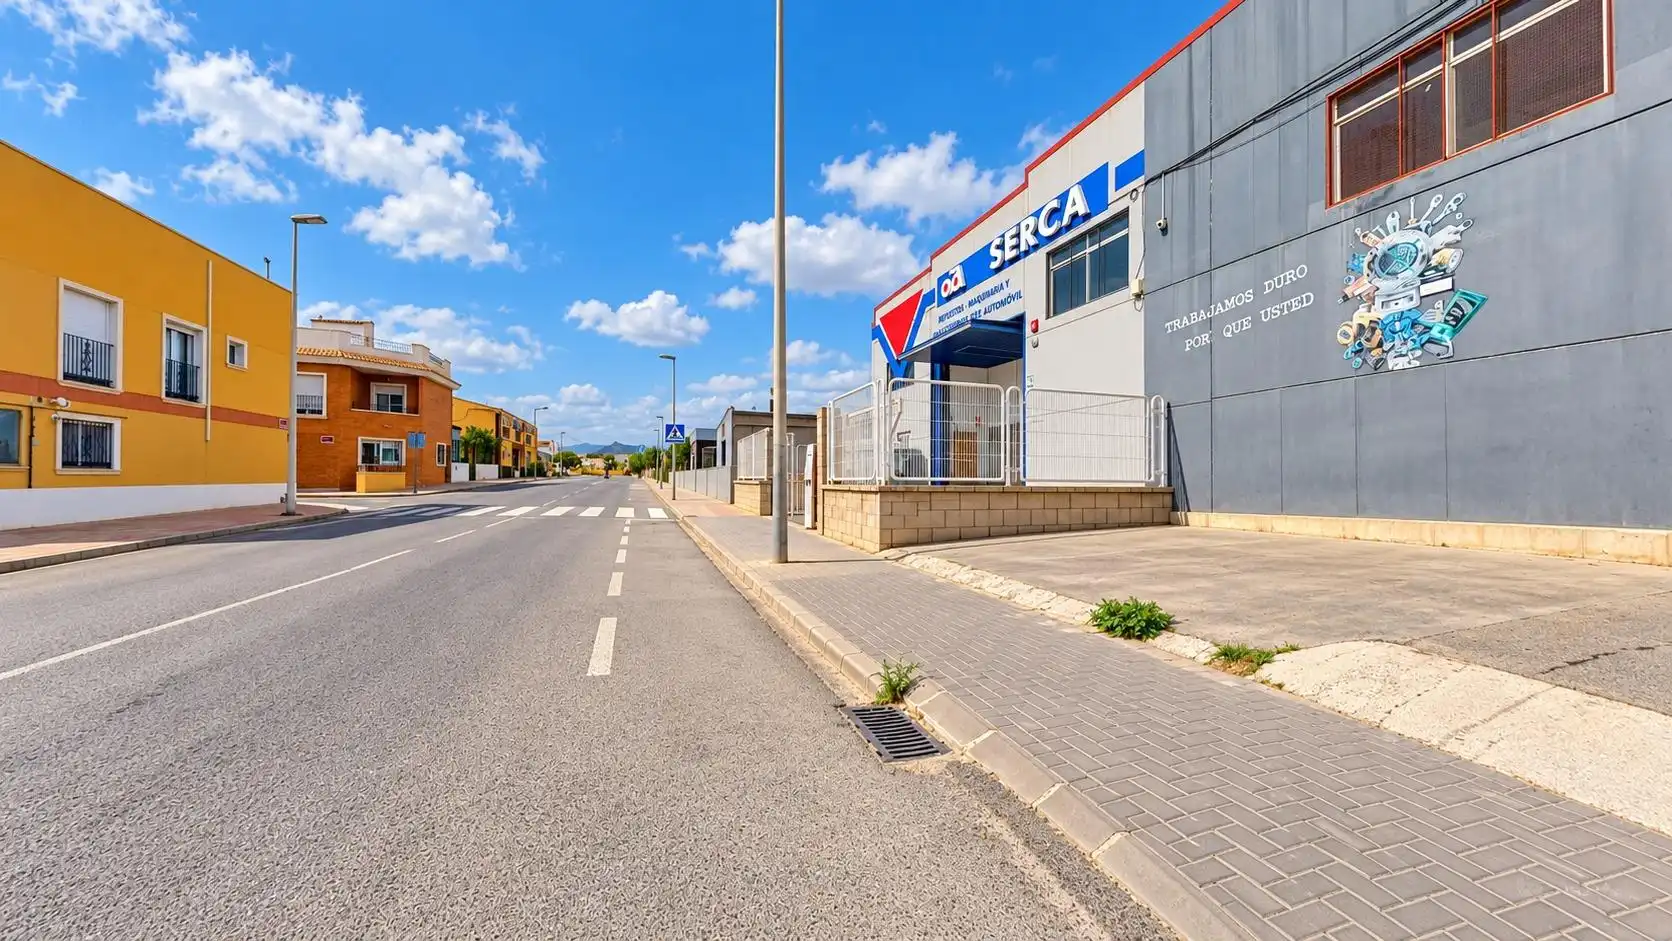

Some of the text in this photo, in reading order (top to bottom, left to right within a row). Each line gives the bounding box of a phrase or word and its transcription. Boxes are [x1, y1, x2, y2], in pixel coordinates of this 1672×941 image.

[988, 183, 1091, 270] SERCA
[983, 289, 1023, 315] AUTOMÓVIL
[1005, 278, 1011, 288] Y
[1164, 264, 1308, 333] TRABAJAMOS DURO
[1184, 292, 1315, 352] POR QUE USTED
